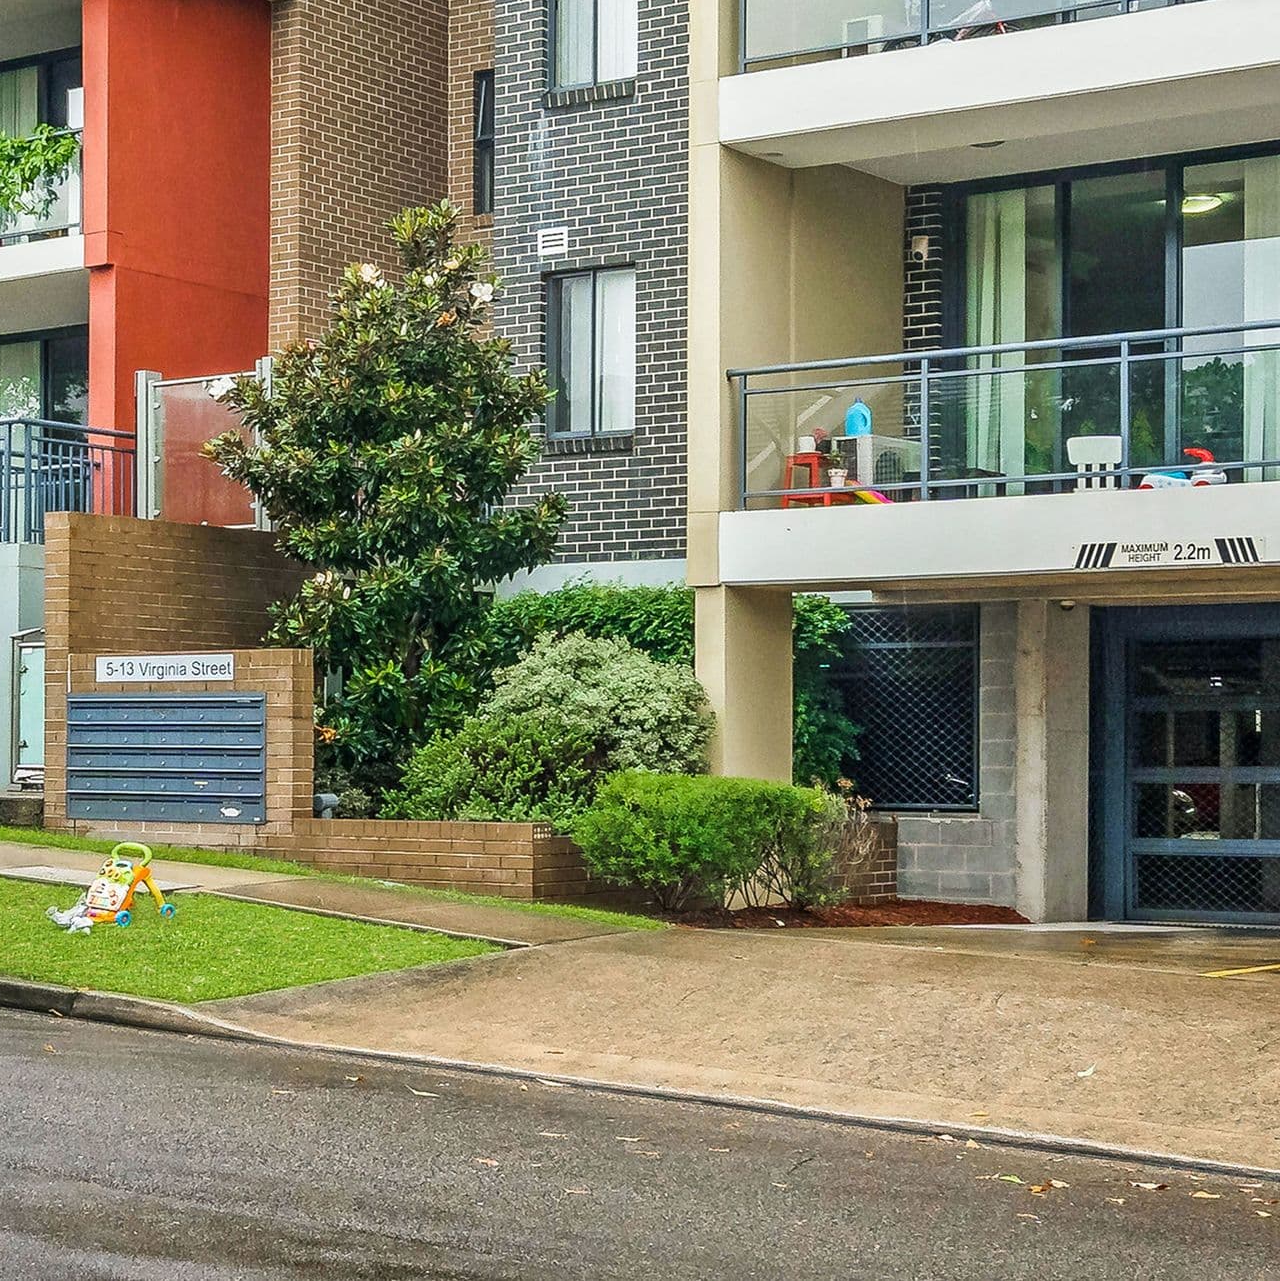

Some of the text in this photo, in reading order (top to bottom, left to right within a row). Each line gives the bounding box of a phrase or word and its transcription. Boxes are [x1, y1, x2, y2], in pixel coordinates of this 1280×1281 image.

[1121, 541, 1169, 553] MAXIMUM
[1173, 543, 1211, 561] 2.2m
[1128, 553, 1162, 563] HEIGHT
[105, 660, 232, 680] 5-13 Virginia Street
